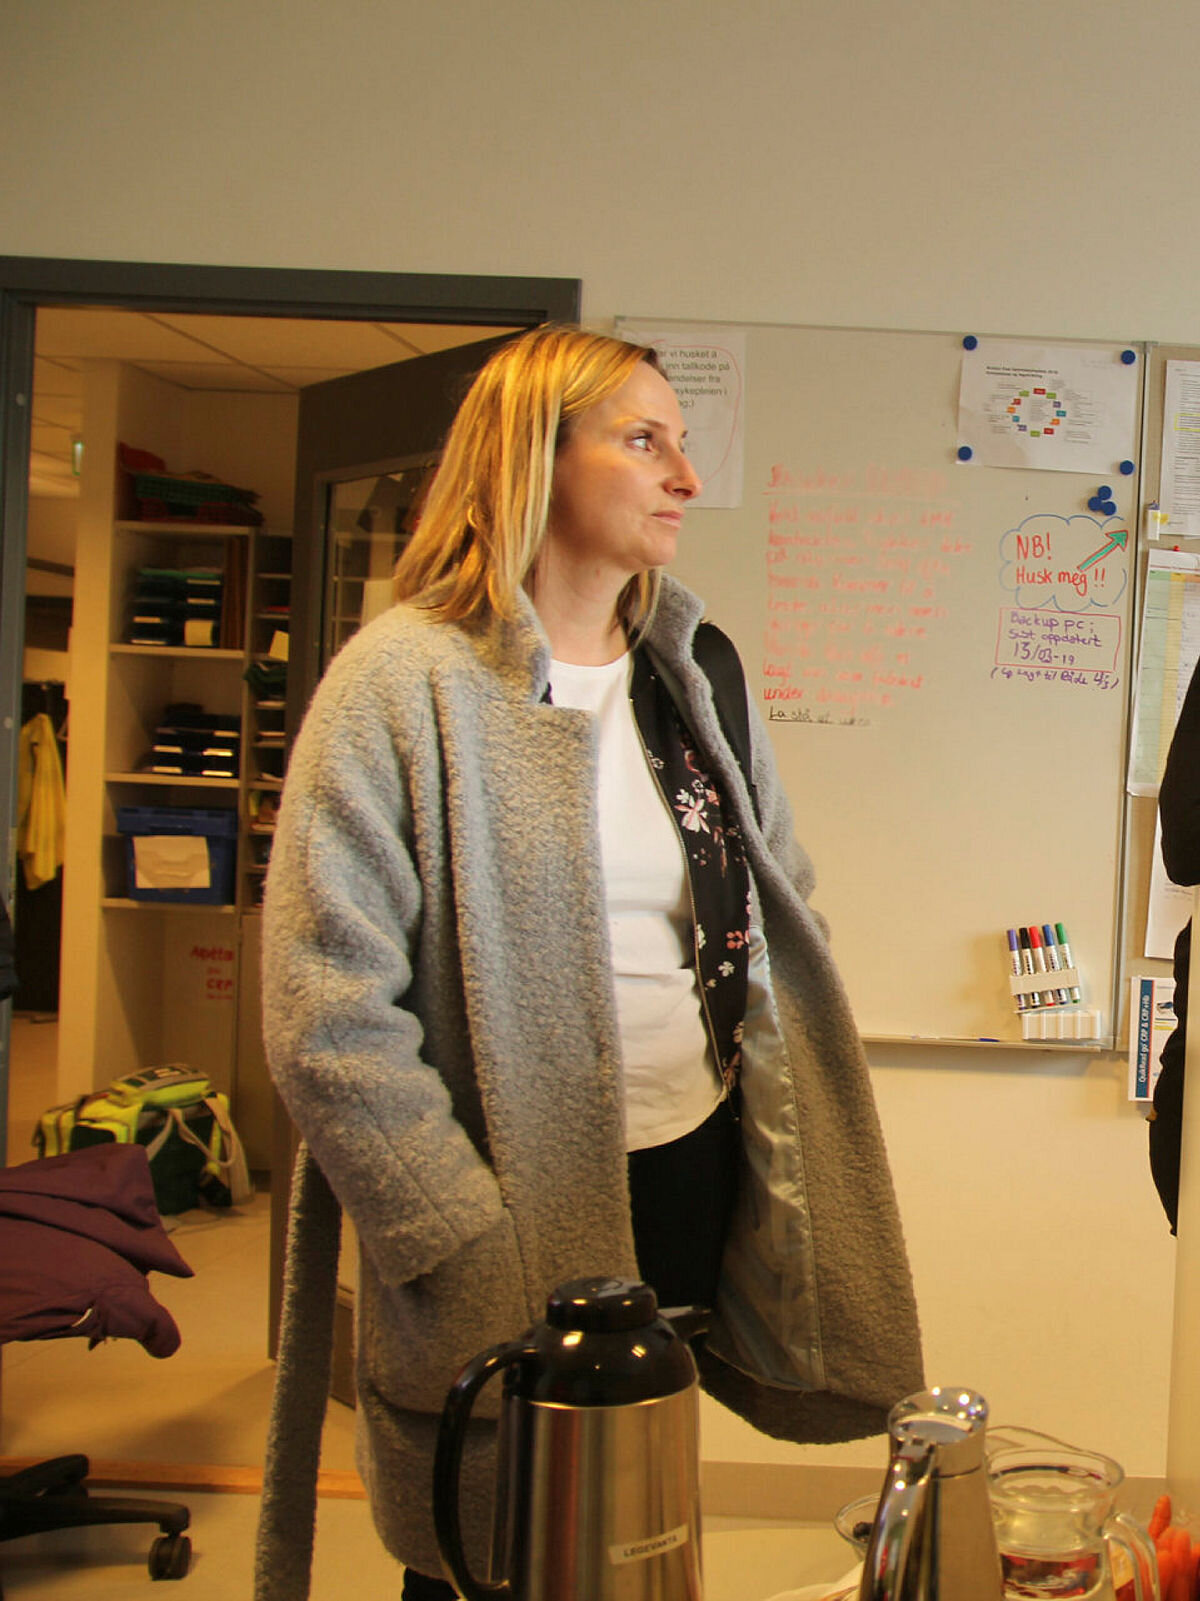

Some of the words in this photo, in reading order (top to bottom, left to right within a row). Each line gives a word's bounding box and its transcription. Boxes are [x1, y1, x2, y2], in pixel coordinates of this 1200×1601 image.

[680, 350, 709, 358] husket
[682, 361, 717, 370] tallkode
[718, 362, 730, 372] på
[708, 374, 720, 382] fra
[1016, 532, 1052, 561] NB!
[1016, 566, 1053, 585] Husk
[1057, 571, 1088, 597] meg
[1010, 611, 1059, 632] Backup
[1140, 1028, 1149, 1042] CRP
